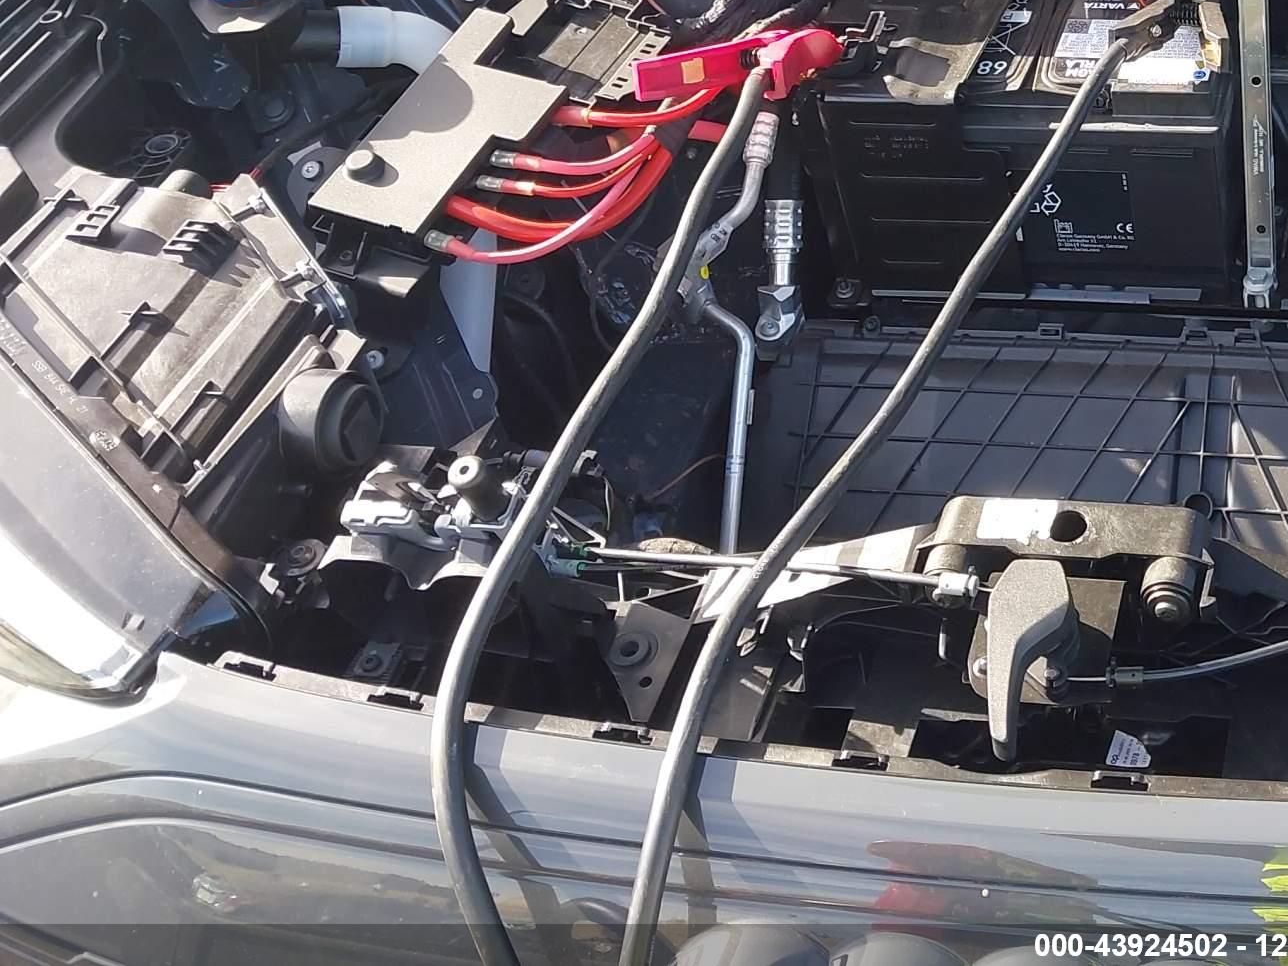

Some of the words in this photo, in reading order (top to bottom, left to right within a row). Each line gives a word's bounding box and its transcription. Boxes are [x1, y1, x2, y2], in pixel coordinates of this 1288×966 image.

[1084, 2, 1126, 10] VARTA
[977, 60, 1008, 75] 68
[1116, 223, 1134, 234] CE
